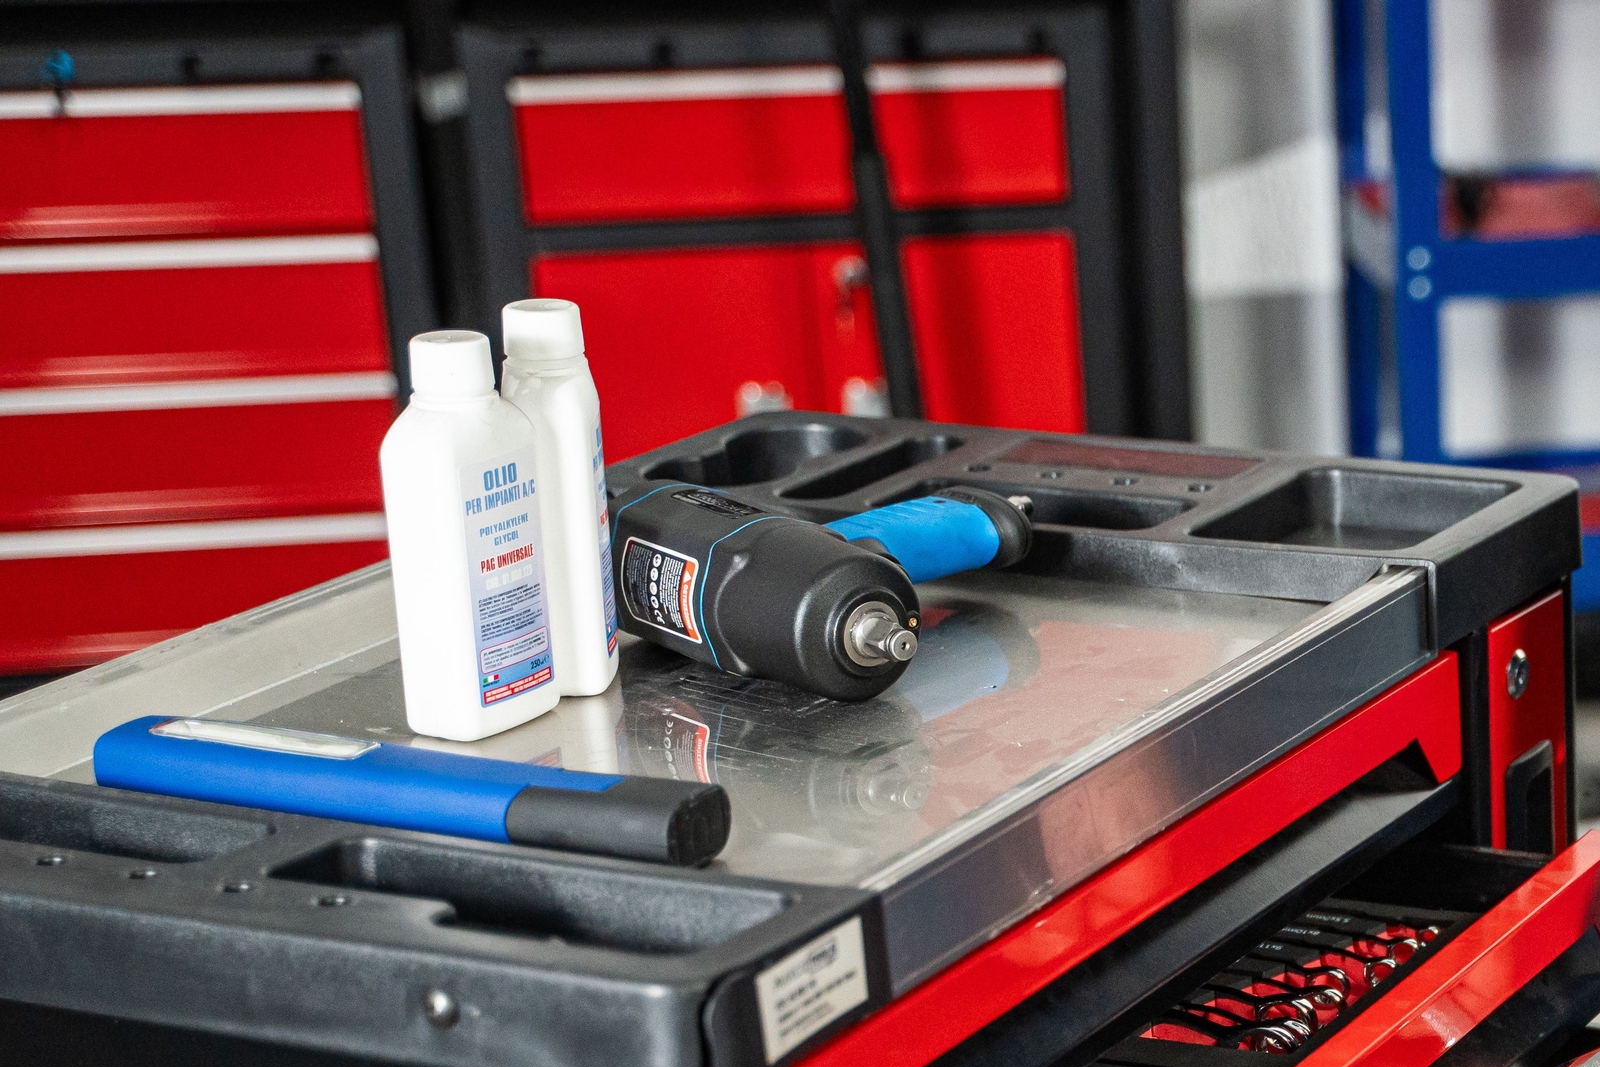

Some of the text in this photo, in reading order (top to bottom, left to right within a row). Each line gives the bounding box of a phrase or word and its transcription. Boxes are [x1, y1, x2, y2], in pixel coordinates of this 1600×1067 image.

[483, 462, 517, 491] OLIO
[466, 479, 536, 516] PER IMPIANTI A/C
[480, 512, 528, 538] POLYALKYLENE
[494, 530, 519, 546] GLYCOL
[480, 543, 534, 574] PAG UNIVERSALE
